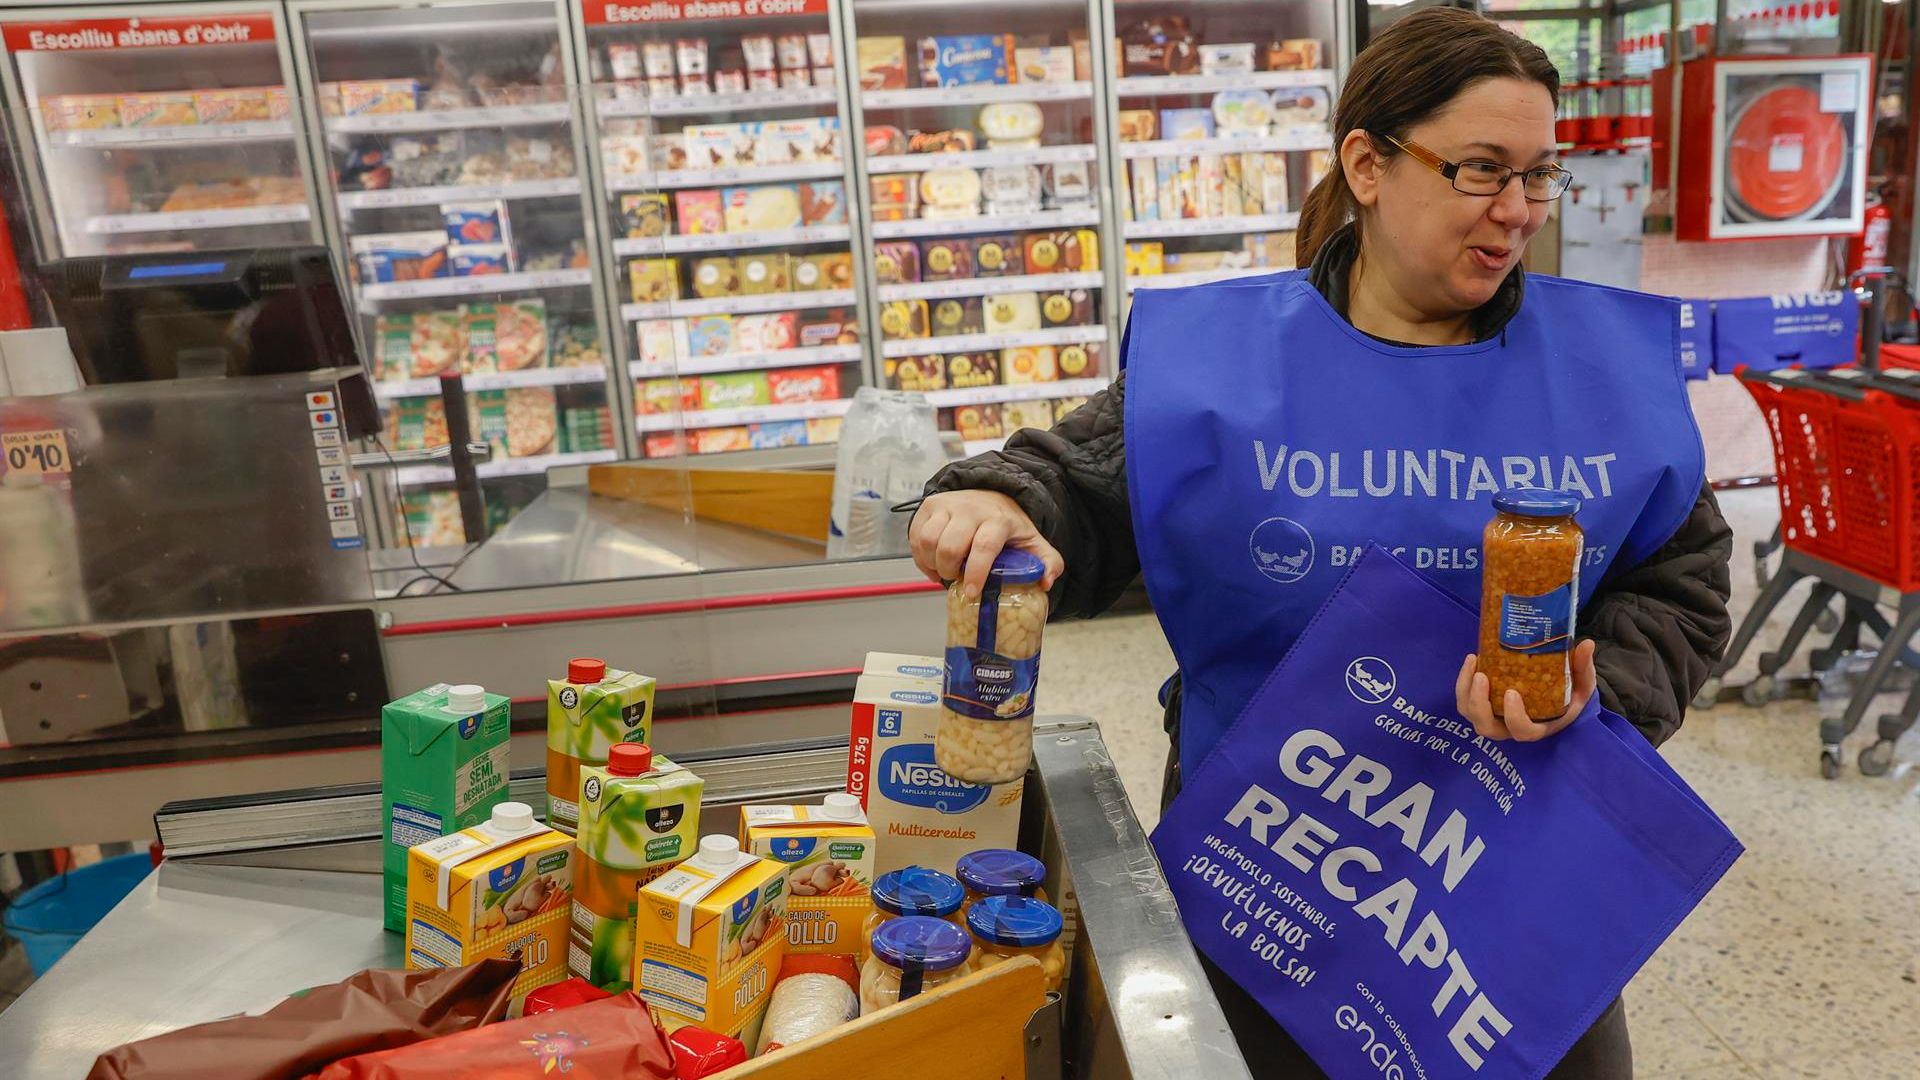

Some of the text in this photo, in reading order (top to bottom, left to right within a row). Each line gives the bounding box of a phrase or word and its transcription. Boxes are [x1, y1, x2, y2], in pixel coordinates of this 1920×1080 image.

[604, 3, 681, 22] Escolliu
[683, 0, 742, 18] abans
[29, 23, 251, 50] Escolliu abans d'obrir
[1253, 440, 1617, 500] VOLUNTARIAT
[1415, 547, 1479, 569] DELS
[976, 667, 1011, 679] CIDACOS
[885, 717, 895, 729] 6
[1373, 713, 1422, 744] GRACIAS
[1424, 734, 1451, 755] POR
[1450, 747, 1469, 767] LA
[1391, 696, 1526, 799] BANC DELS ALIMENTS
[469, 760, 493, 786] SEMI
[851, 737, 870, 799] ICO 375g
[463, 772, 502, 804] DESNATADA
[1278, 728, 1486, 893] GRAN
[889, 823, 976, 841] Multicereales
[781, 849, 804, 857] alteza
[1202, 833, 1338, 939] HAGÁMOSLO SOSTENIBLE,
[787, 910, 825, 921] CALDO DE
[1223, 783, 1514, 1072] RECAPTE
[1221, 910, 1317, 988] LA BOLSA!
[733, 967, 767, 1015] POLLO
[1356, 982, 1375, 1003] con
[1374, 1000, 1389, 1014] la
